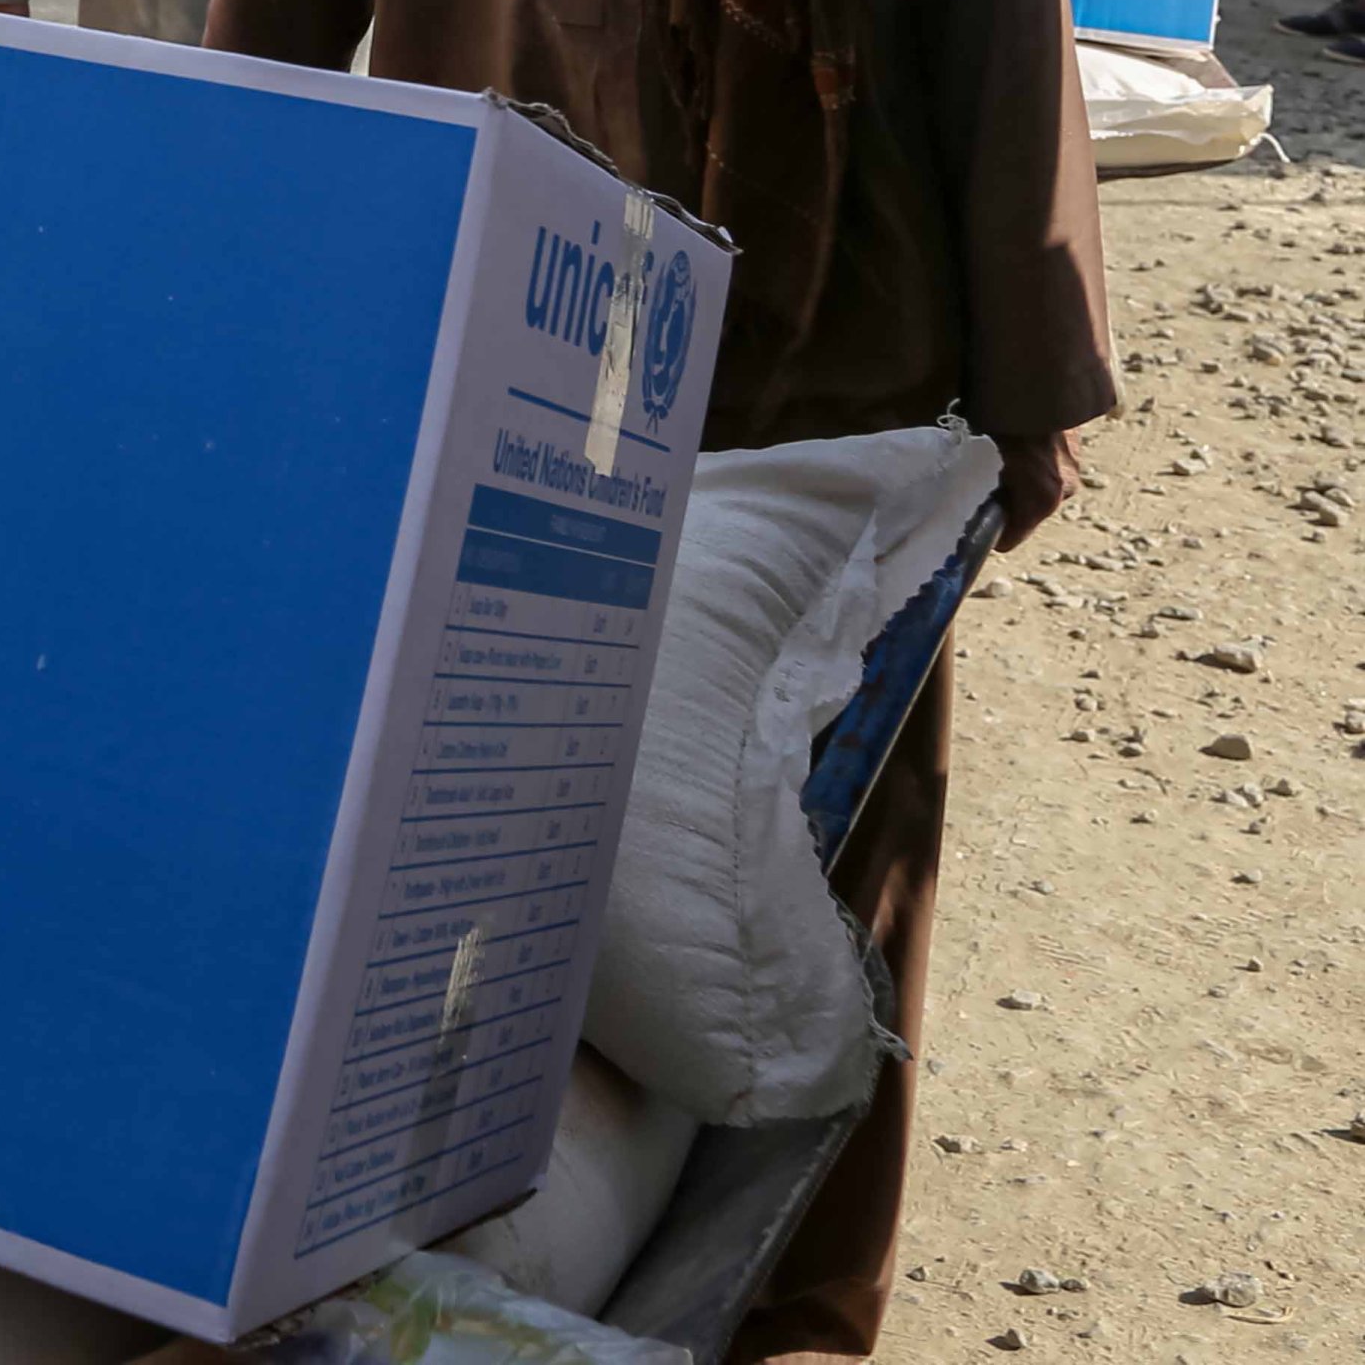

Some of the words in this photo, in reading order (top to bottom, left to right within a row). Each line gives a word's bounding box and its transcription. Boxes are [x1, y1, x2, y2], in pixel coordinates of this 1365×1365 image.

[493, 427, 543, 483] United
[540, 442, 589, 498] Nations
[638, 476, 667, 519] Fund
